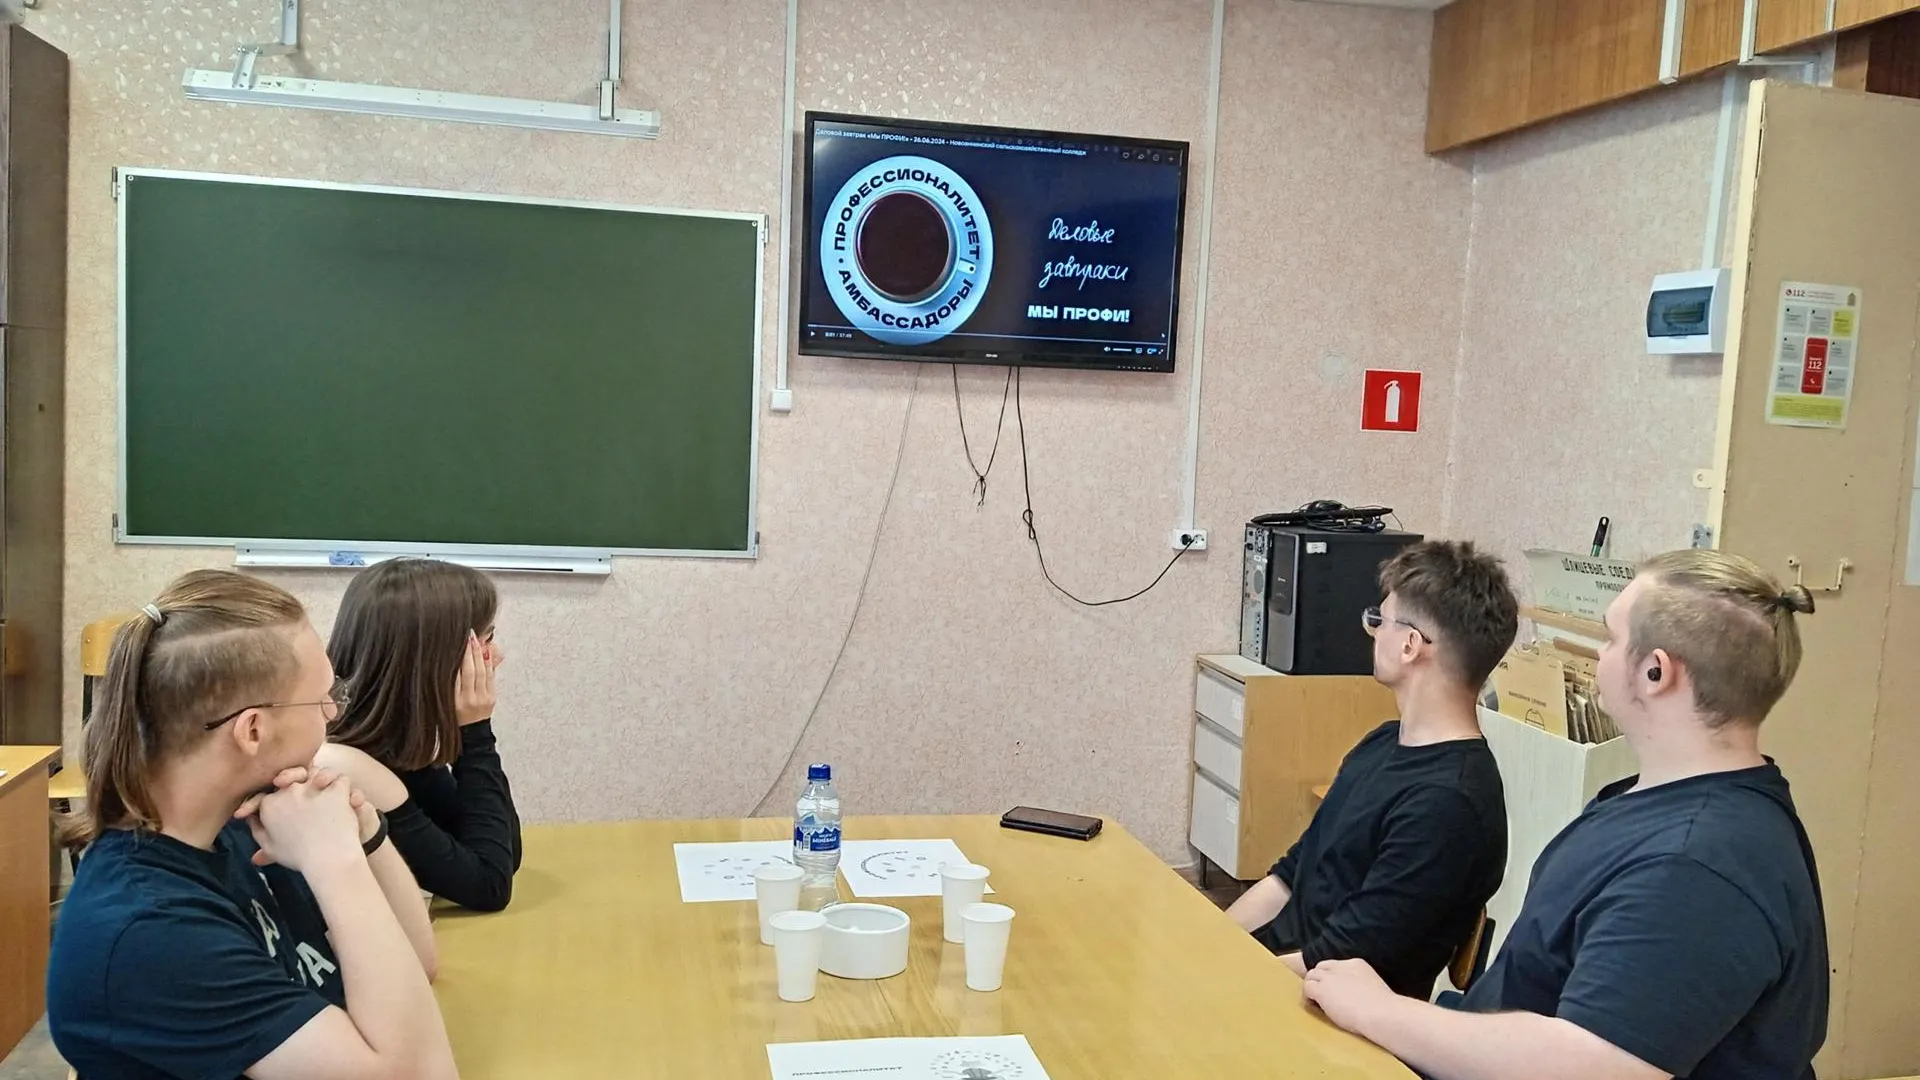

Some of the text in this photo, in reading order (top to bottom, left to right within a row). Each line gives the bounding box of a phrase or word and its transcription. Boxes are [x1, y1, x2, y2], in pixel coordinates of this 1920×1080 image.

[843, 131, 866, 139] завтрак
[834, 168, 980, 260] ПРОФЕССИОНАЛИТЕТ
[1048, 217, 1115, 244] Деловые
[1038, 255, 1129, 291] завтраки
[838, 269, 975, 330] АМБАССАДОРЫ
[1027, 304, 1131, 323] МЫ ПРОФИ!
[1808, 360, 1823, 370] 112
[1561, 557, 1607, 577] ШЛИЦЕВЫЕ
